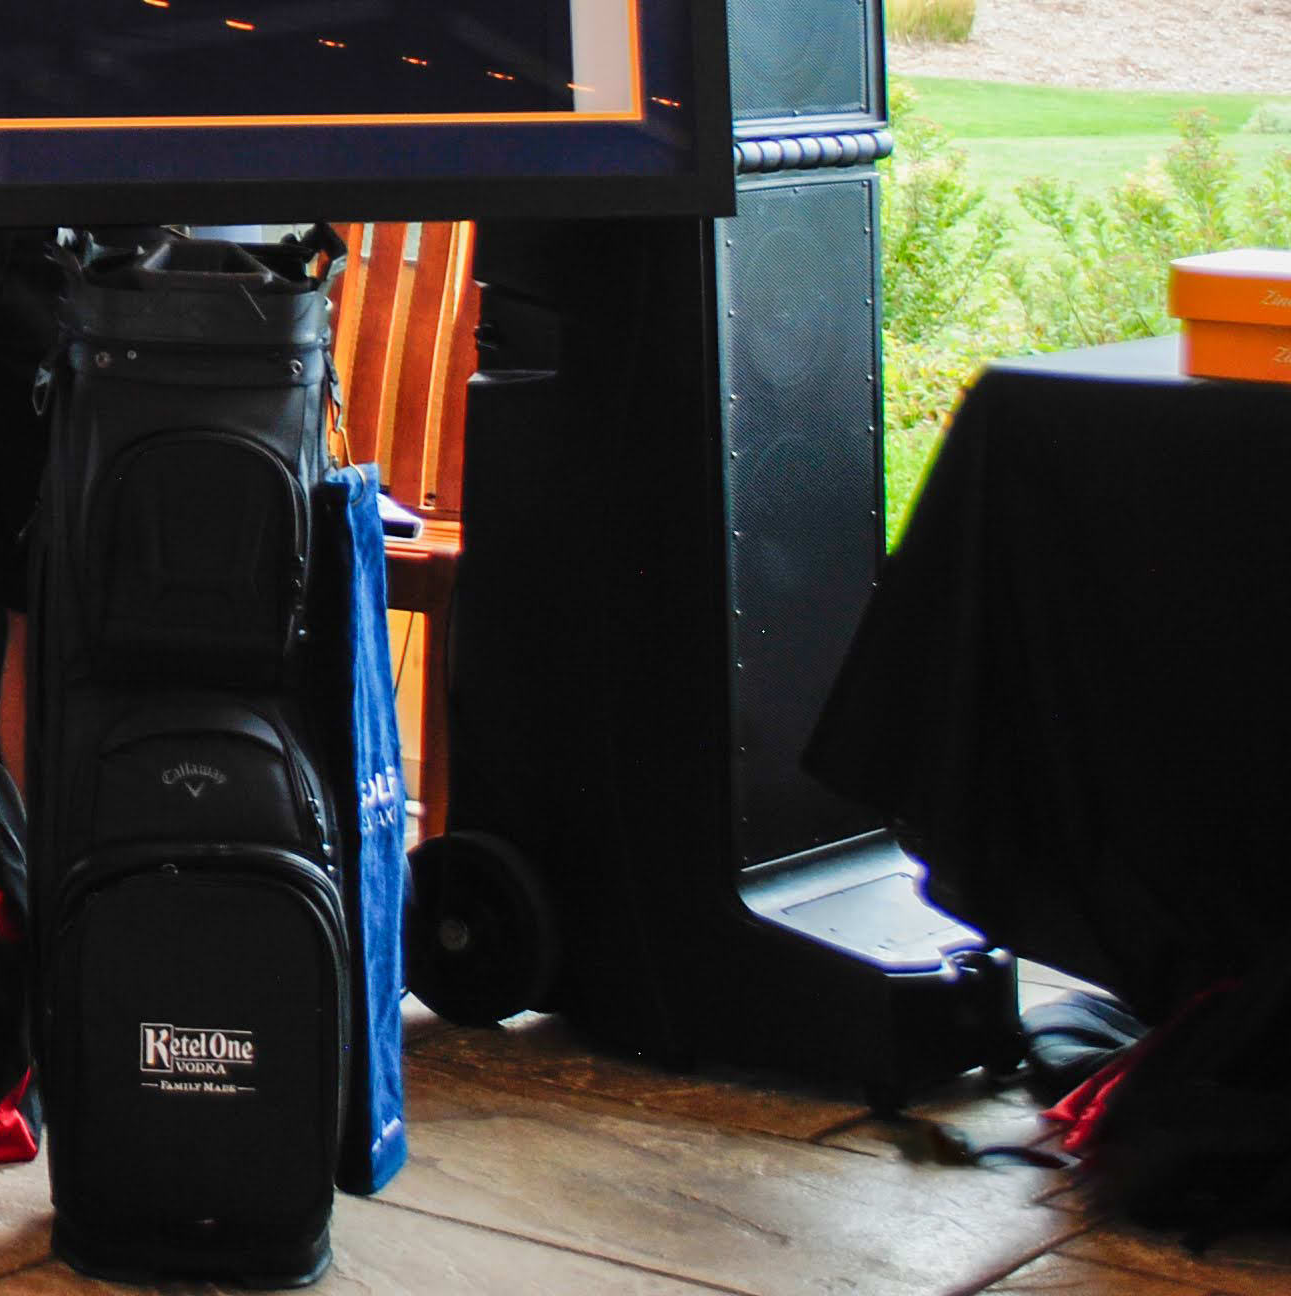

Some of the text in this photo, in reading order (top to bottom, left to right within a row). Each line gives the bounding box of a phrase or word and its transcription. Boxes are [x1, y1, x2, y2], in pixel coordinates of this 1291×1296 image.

[144, 1027, 253, 1068] Ketel One
[175, 1061, 227, 1075] VODKA
